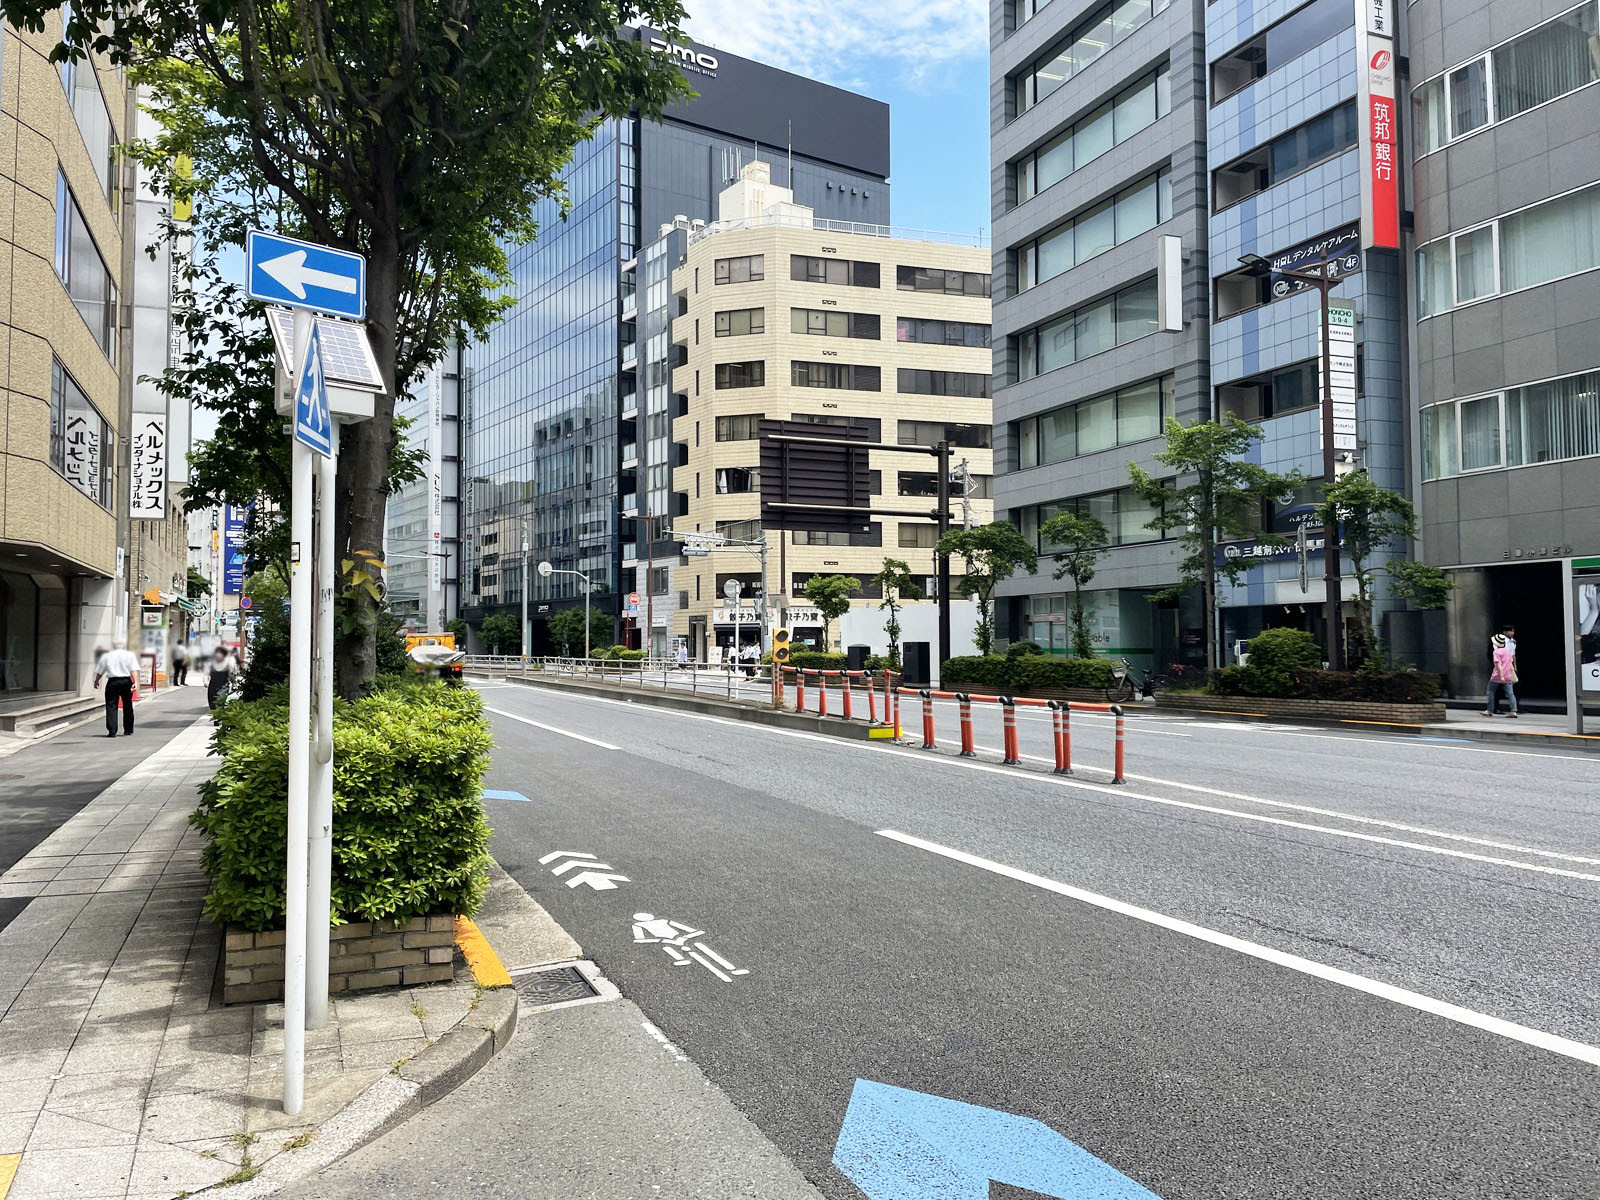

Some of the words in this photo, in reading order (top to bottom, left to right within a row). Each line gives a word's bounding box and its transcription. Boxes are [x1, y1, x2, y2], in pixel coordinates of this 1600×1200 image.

[1374, 102, 1392, 181] 筑邦銀行
[1346, 257, 1356, 268] 4F
[146, 421, 164, 510] ベルメックス
